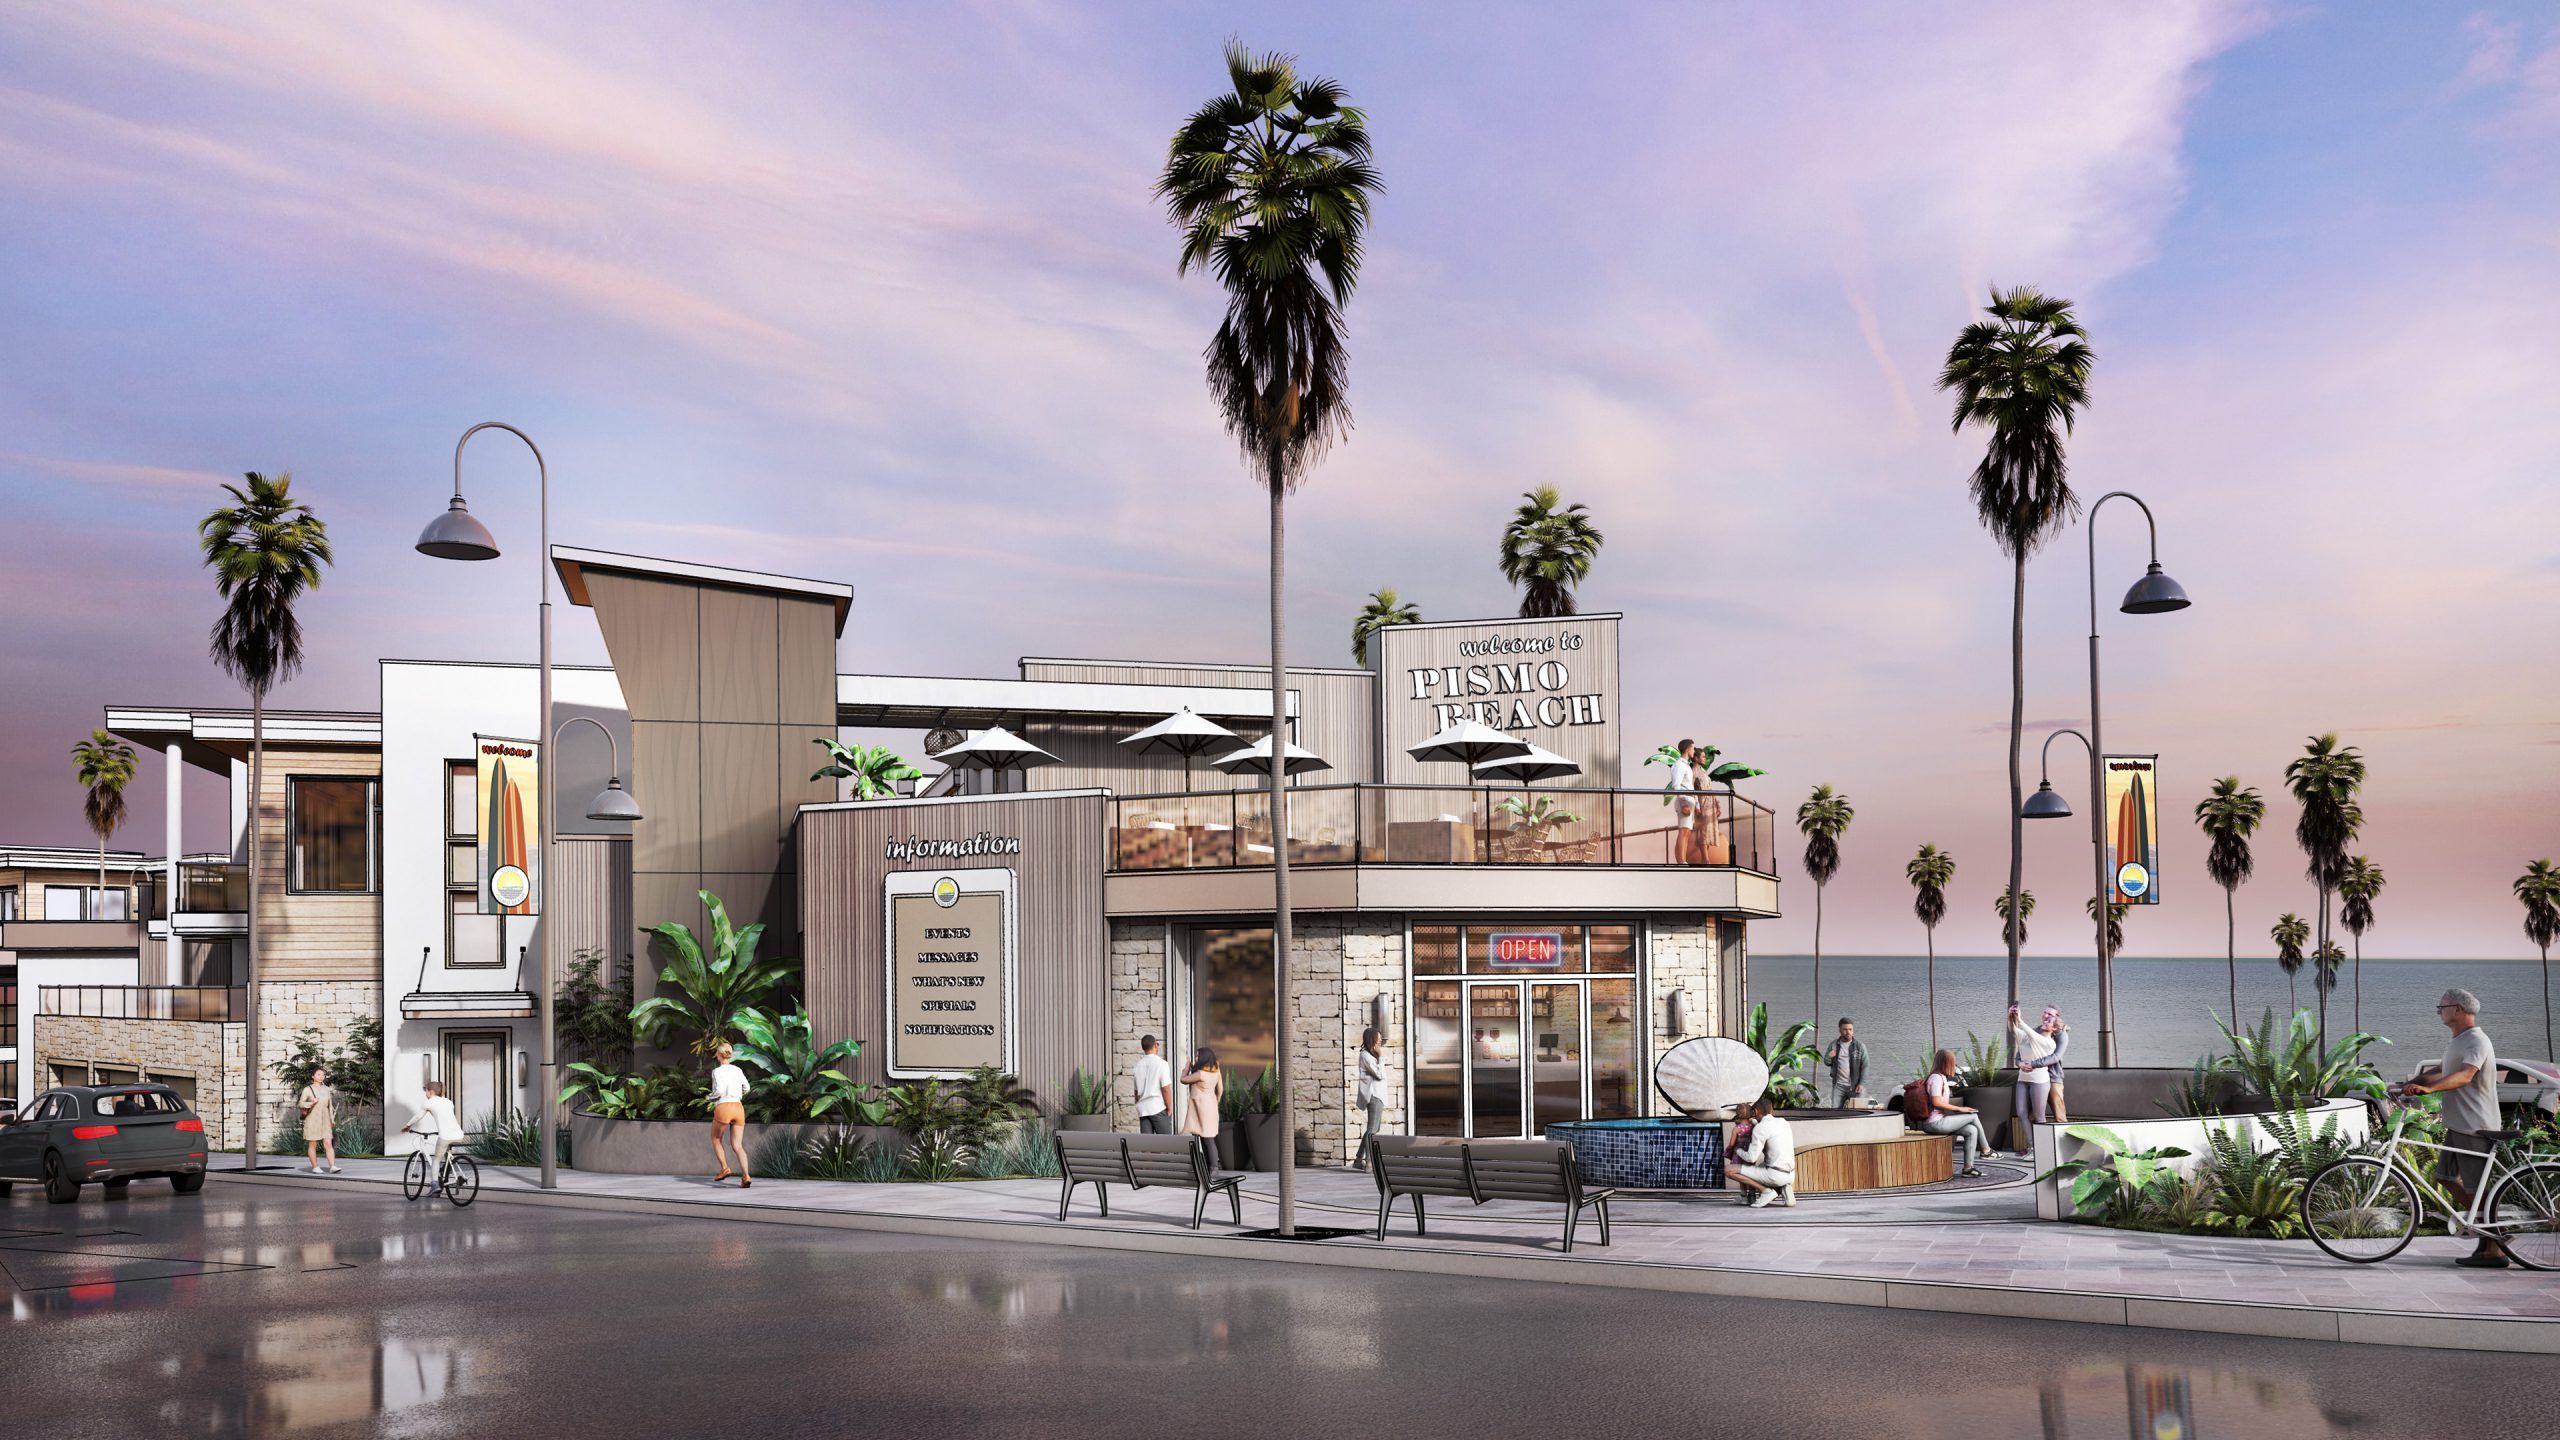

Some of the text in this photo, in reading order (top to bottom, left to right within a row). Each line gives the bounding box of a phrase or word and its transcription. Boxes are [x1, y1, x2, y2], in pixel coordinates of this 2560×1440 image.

[1459, 630, 1583, 657] welcome to
[1408, 660, 1569, 700] PISMO
[1432, 693, 1605, 735] BEACH
[482, 743, 532, 759] welcome
[886, 832, 1021, 863] information
[925, 927, 970, 939] EVENTS
[917, 952, 978, 963] MESSAGES
[1501, 939, 1551, 961] OPEN
[912, 976, 985, 987] WHAT'S NEW
[921, 1000, 976, 1011] SPECIALS
[904, 1024, 994, 1036] NOTIFICATIONS
